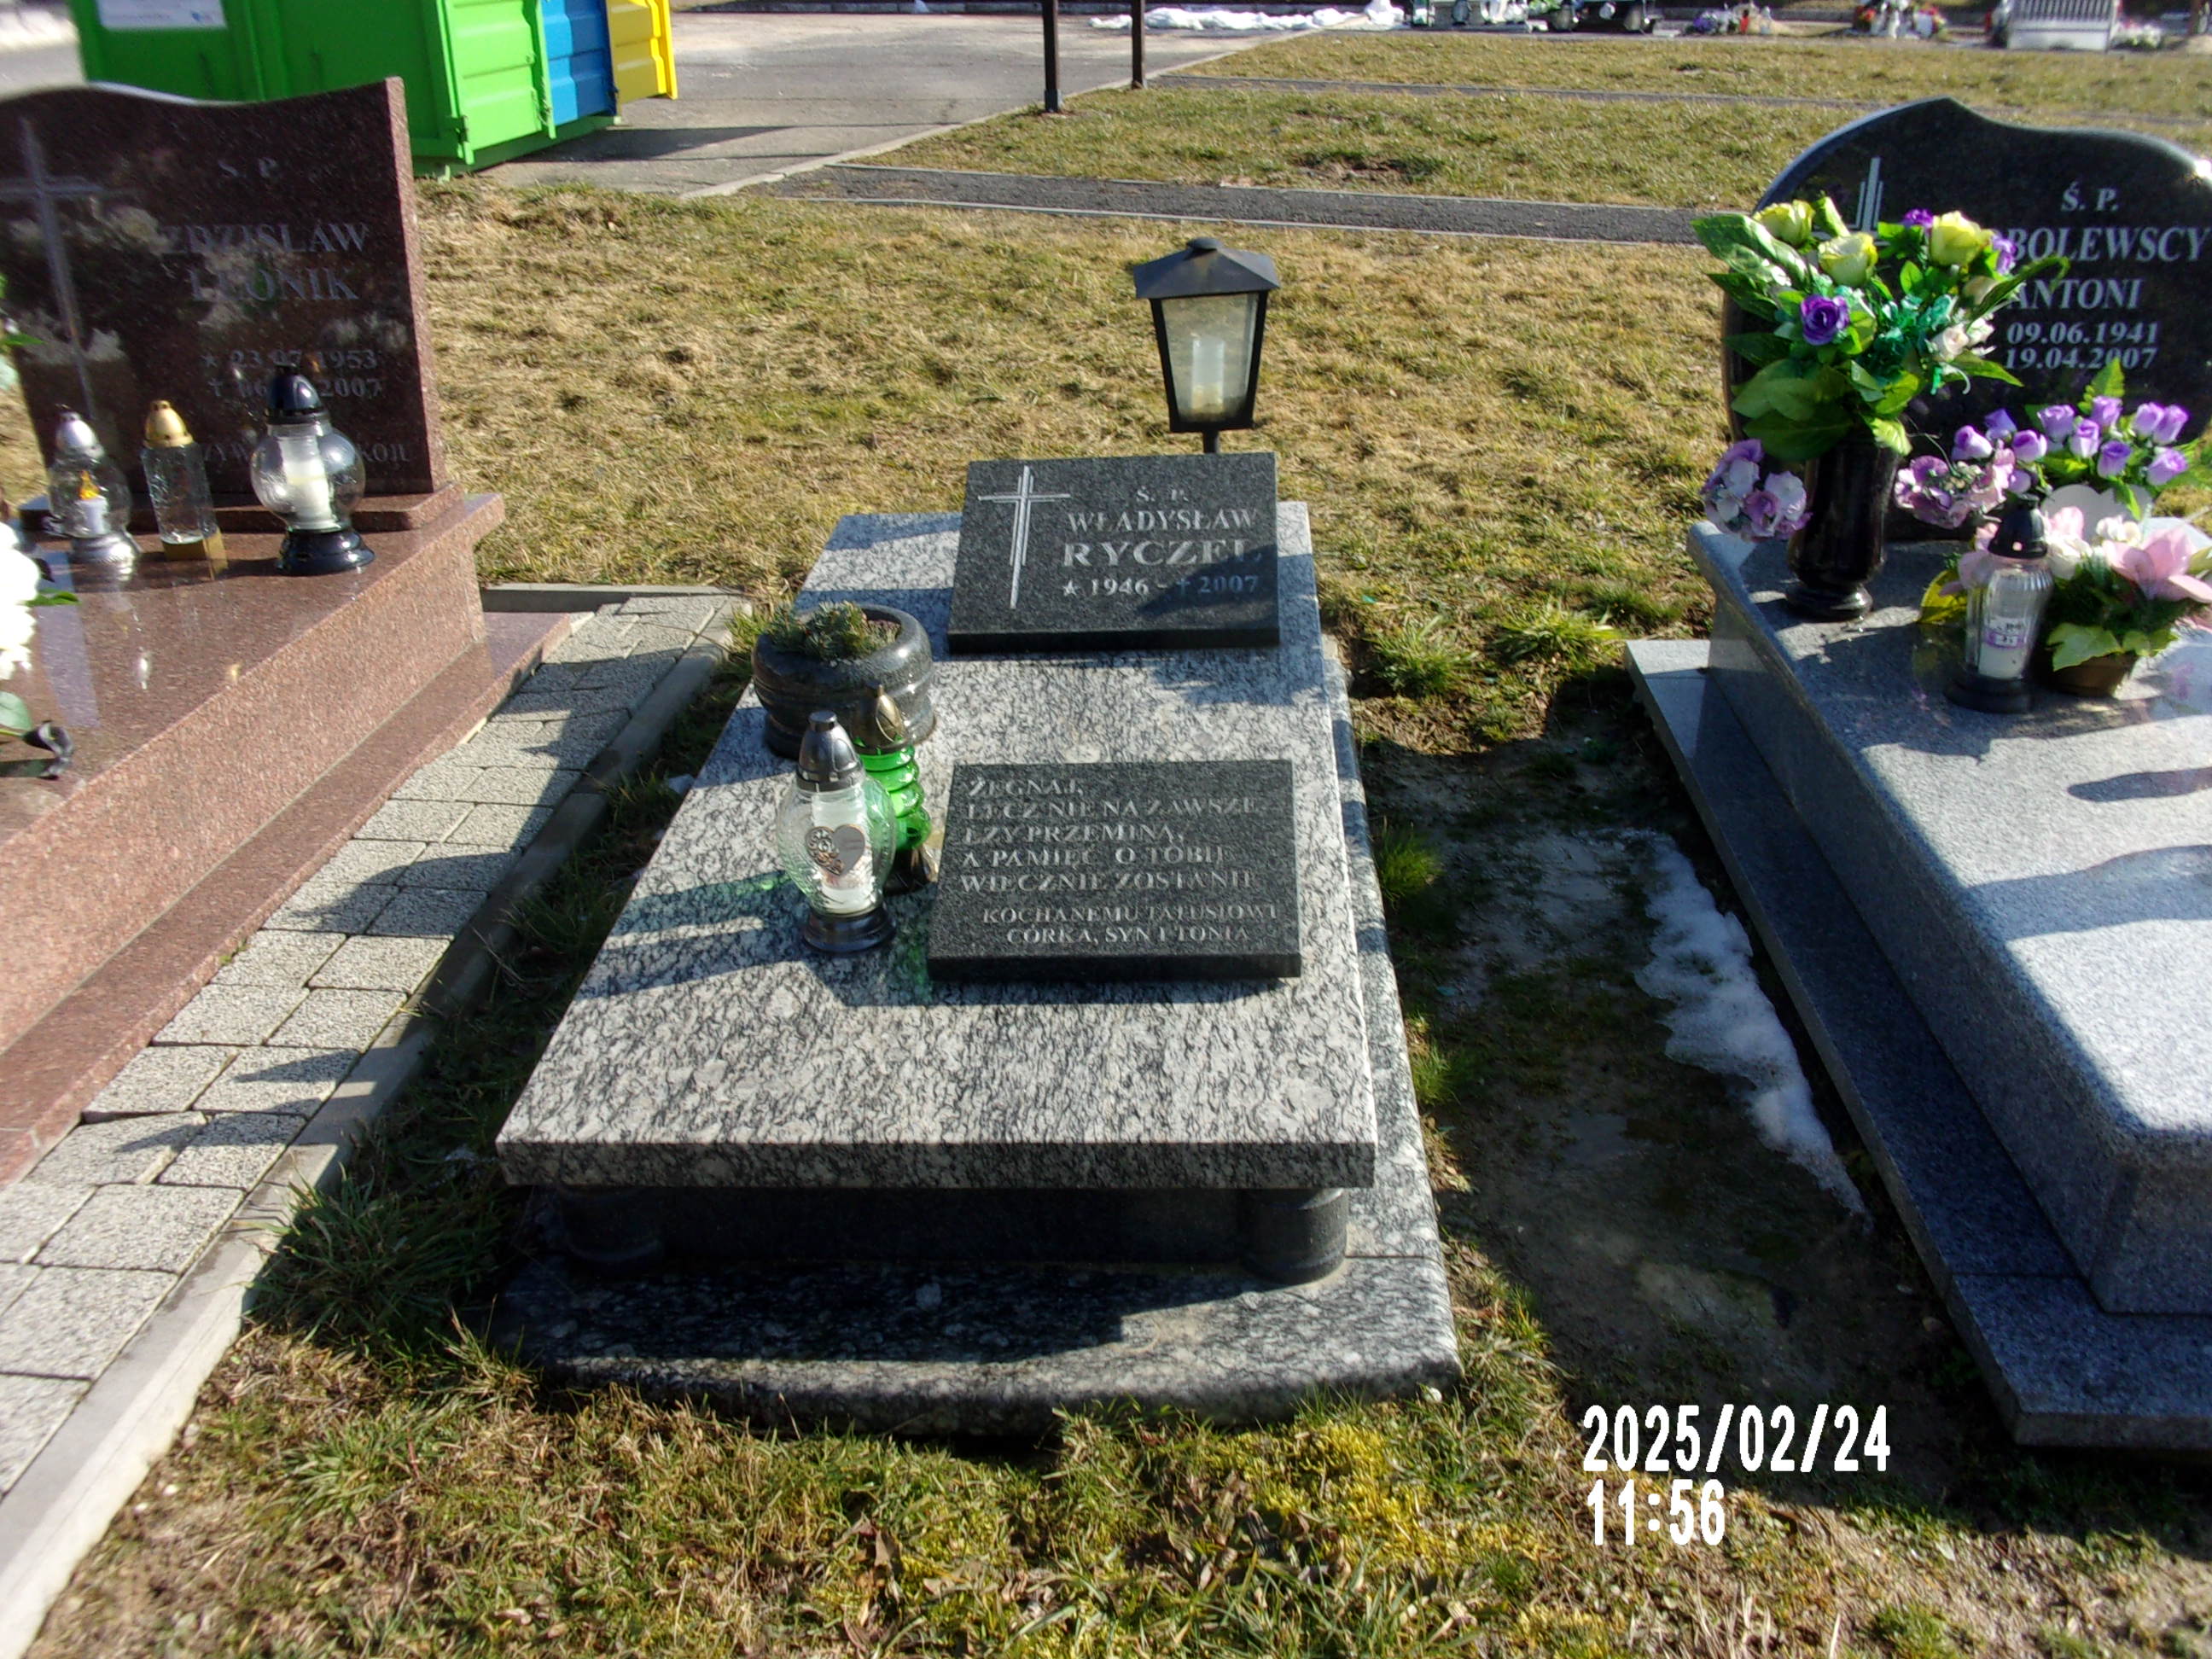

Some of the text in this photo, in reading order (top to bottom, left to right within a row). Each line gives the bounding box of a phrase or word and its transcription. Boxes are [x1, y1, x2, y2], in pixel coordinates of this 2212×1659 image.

[2061, 181, 2118, 212] Ś. P.
[2007, 227, 2212, 262] BOLEWSCY
[2007, 278, 2145, 309] ANTONI
[2007, 322, 2159, 344] 09.06.1941
[2005, 346, 2158, 369] 19.04.2007
[1066, 508, 1258, 533] WŁADYSŁAW
[1091, 577, 1150, 597] 1946
[1197, 574, 1260, 595] 2007
[967, 801, 1039, 819] LECZ
[1048, 800, 1095, 818] NIE
[1103, 799, 1139, 818] NA
[963, 851, 981, 868] A
[1115, 846, 1137, 864] O
[1146, 845, 1229, 864] TOBIE
[960, 870, 1255, 893] WIECZNIE ZOSTANIE
[983, 906, 1139, 923] KOCHANEMU
[1105, 926, 1151, 943] SYN
